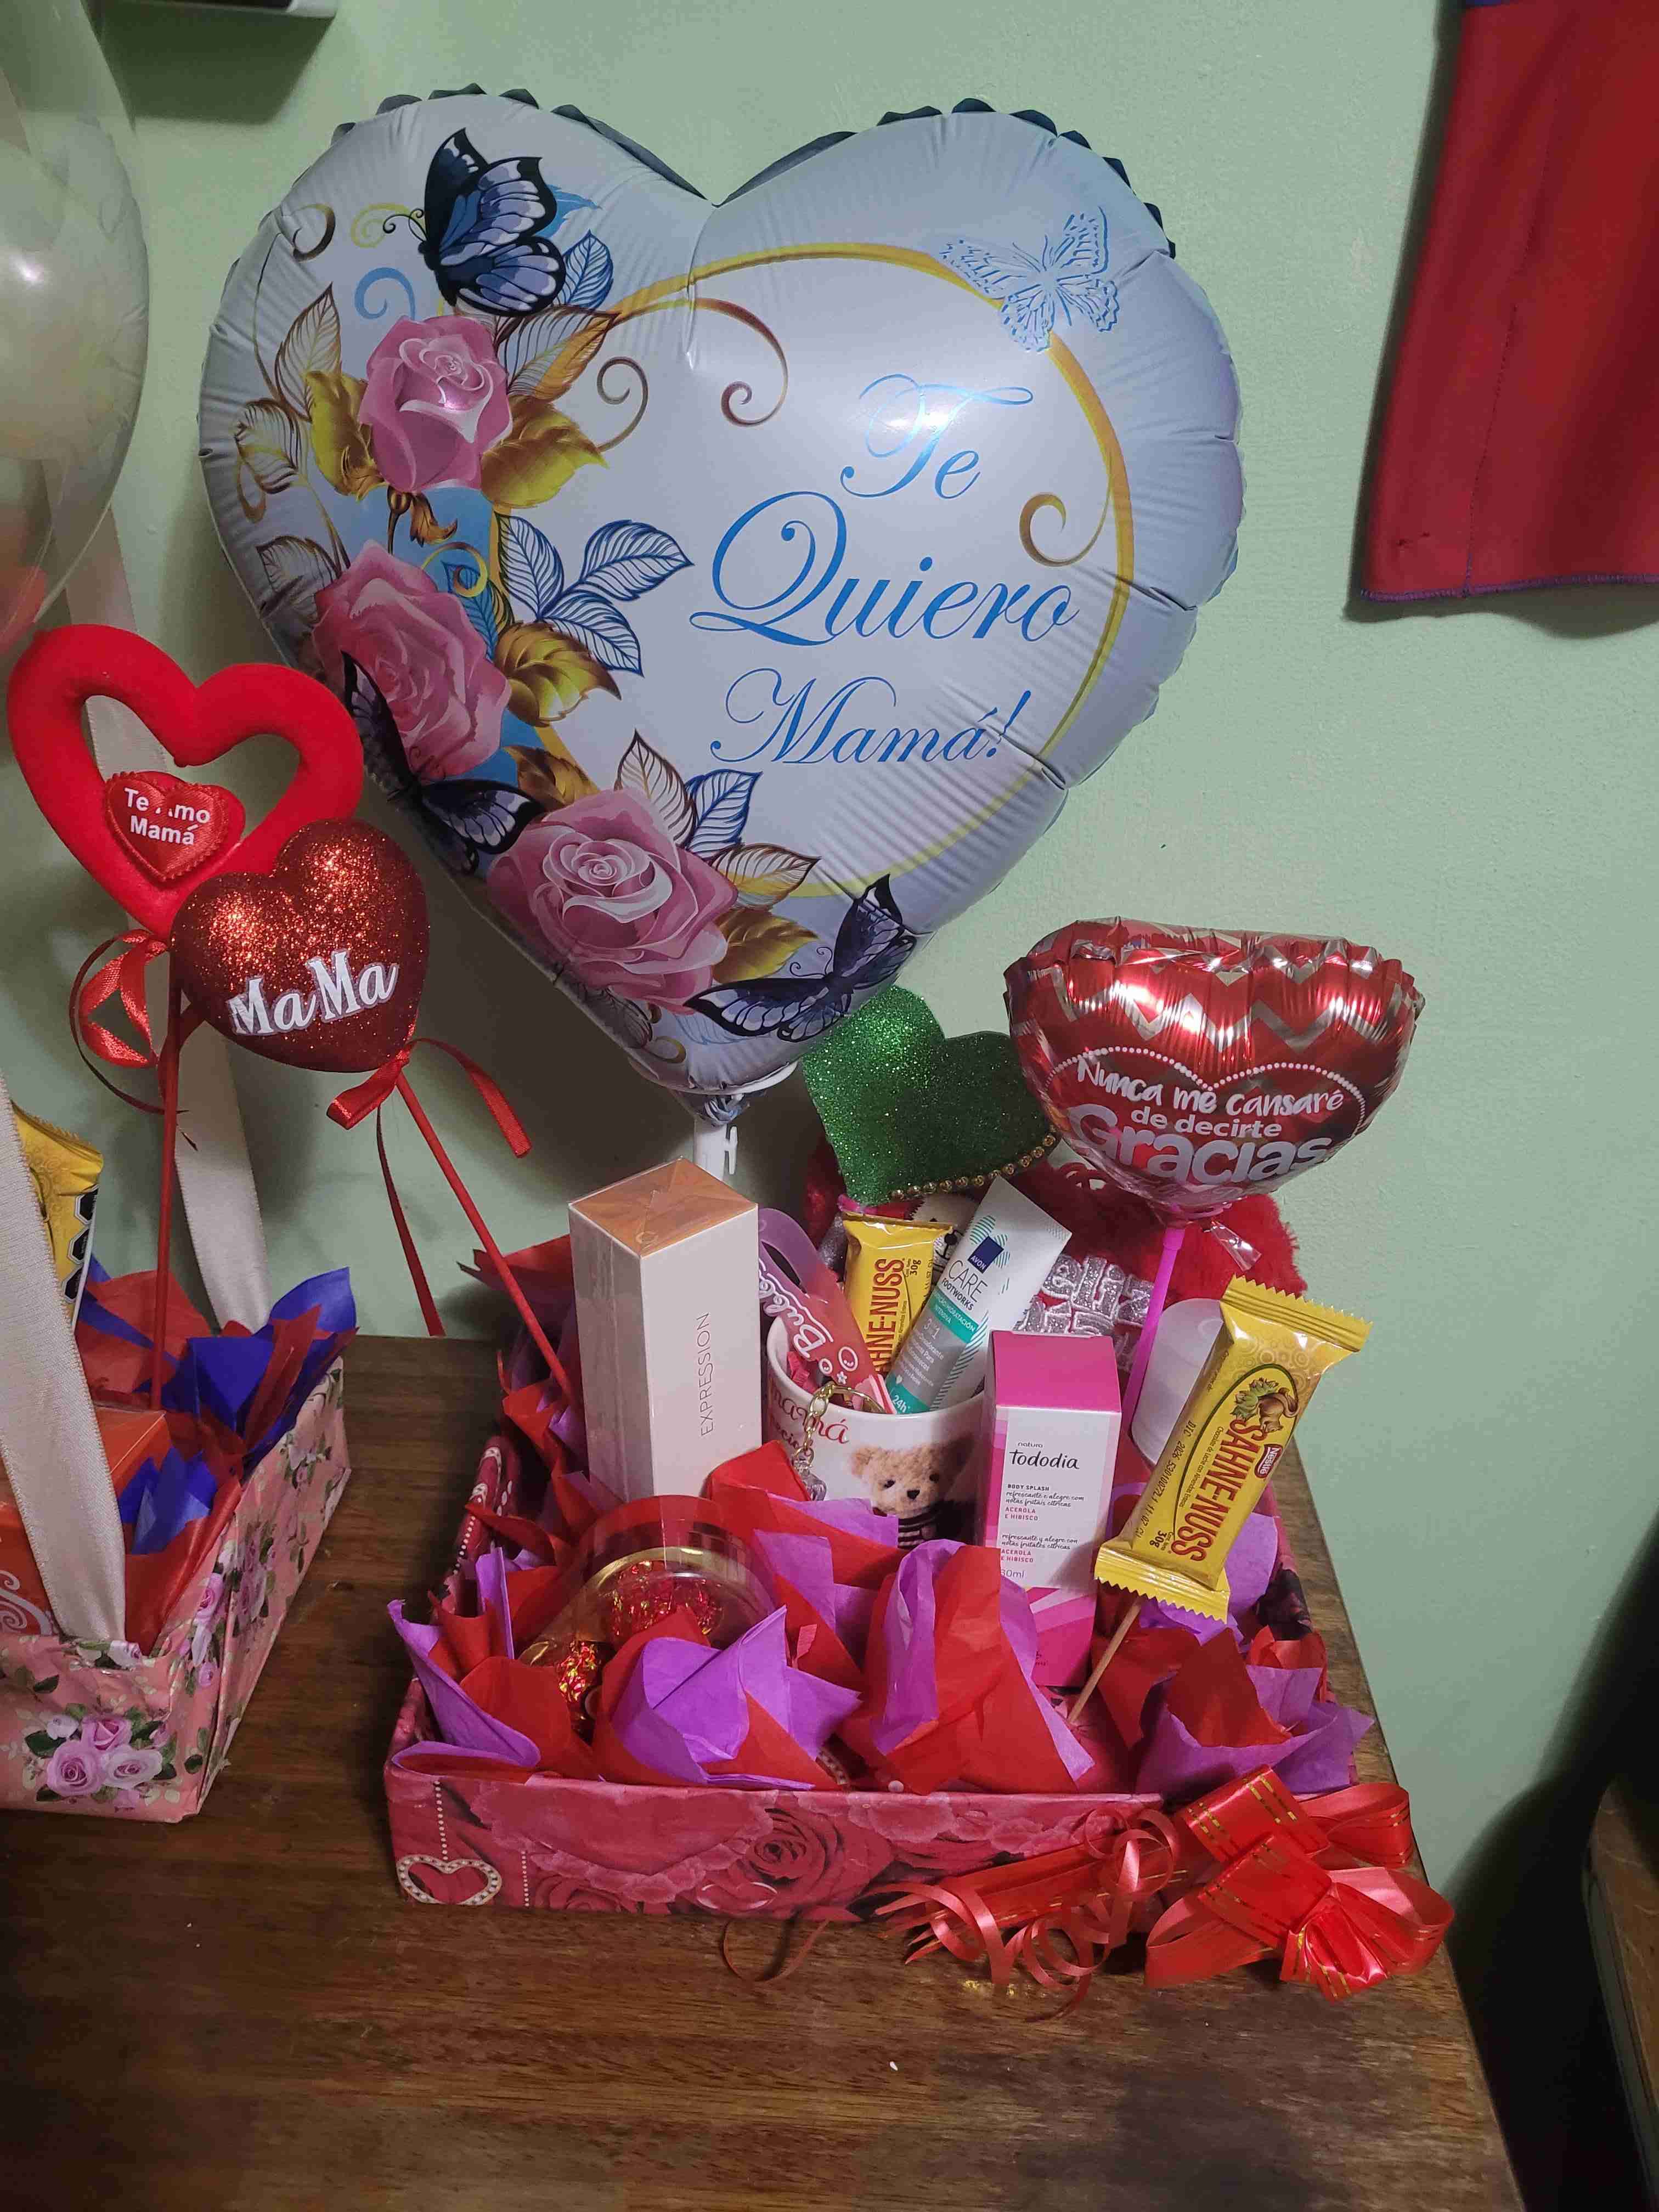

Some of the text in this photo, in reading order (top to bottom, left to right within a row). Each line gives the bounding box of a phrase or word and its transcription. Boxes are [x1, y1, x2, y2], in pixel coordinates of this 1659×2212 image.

[840, 374, 1032, 500] Te
[689, 491, 1079, 646] Quiero
[710, 668, 1030, 763] Mamá!
[125, 788, 149, 811] Te
[130, 815, 198, 845] Mamá
[228, 949, 399, 1035] MaMa
[1077, 1058, 1344, 1116] Nunca me cansaré
[1131, 1107, 1282, 1138] de decirte
[1066, 1104, 1333, 1186] Gracias
[910, 1259, 921, 1276] 30g
[970, 1255, 986, 1270] AVON
[941, 1278, 974, 1311] FOOTWORKS
[949, 1260, 988, 1302] CARE
[696, 1313, 714, 1436] EXPRESSION
[1009, 1449, 1080, 1470] tododia
[1172, 1441, 1186, 1460] 2026
[1048, 1493, 1070, 1503] alegre
[1171, 1419, 1268, 1561] SAHNE-NUSS
[1149, 1530, 1167, 1548] 30g
